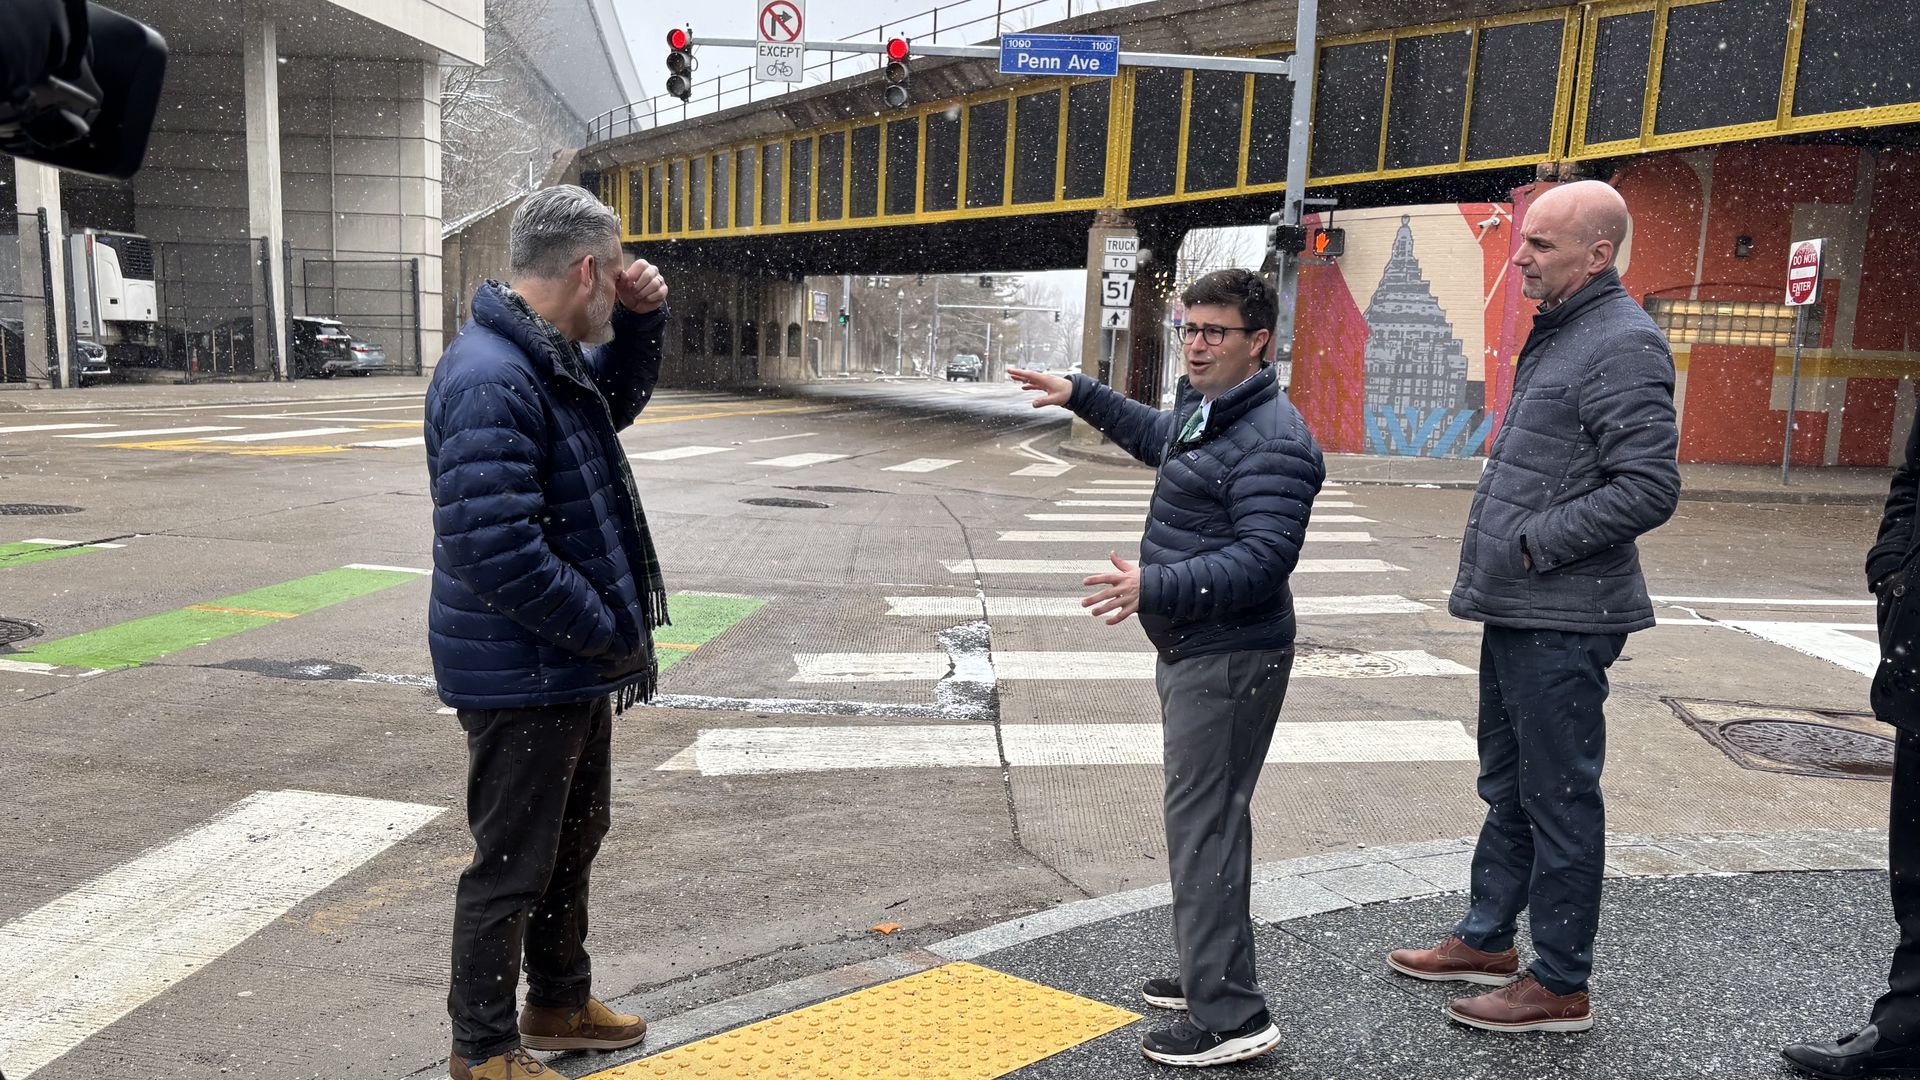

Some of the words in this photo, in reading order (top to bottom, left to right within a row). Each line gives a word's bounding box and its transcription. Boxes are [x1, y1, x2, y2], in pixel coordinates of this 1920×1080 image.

[759, 45, 801, 58] EXCEPT
[1091, 42, 1112, 51] 1100
[1017, 53, 1060, 70] Penn
[1067, 54, 1100, 71] Ave
[1107, 240, 1136, 251] TRUCK
[1112, 258, 1128, 268] TO
[1793, 255, 1802, 266] DO
[1803, 253, 1817, 264] NOT
[1106, 281, 1128, 300] 51
[1791, 281, 1812, 293] ENTER
